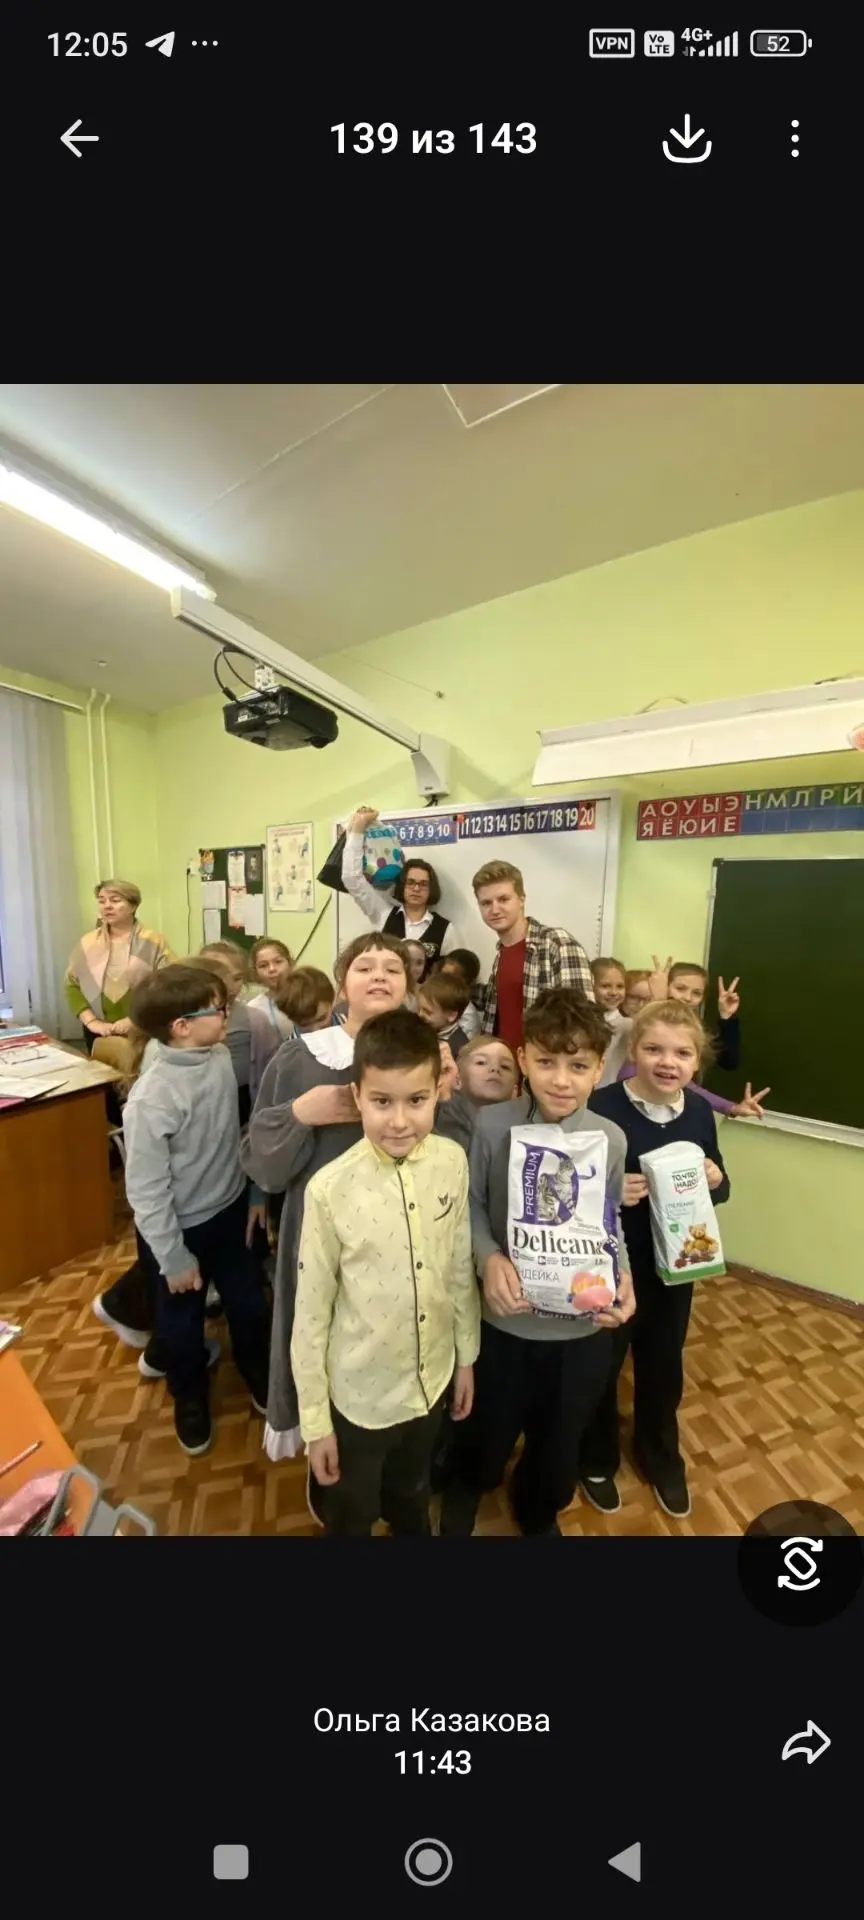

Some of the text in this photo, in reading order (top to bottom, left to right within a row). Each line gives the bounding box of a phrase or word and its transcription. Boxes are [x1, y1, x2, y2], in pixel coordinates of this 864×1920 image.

[399, 828, 406, 840] 6
[408, 826, 415, 839] 7
[417, 825, 425, 839] 8
[426, 824, 434, 837] 9
[436, 823, 450, 837] 10
[471, 816, 482, 834] 12
[483, 815, 494, 833] 13
[495, 814, 507, 832] 14
[509, 813, 521, 831] 15
[523, 812, 535, 830] 16
[536, 810, 549, 828] 17
[550, 809, 563, 827] 18
[565, 808, 579, 826] 19
[580, 808, 595, 826] 20
[524, 1151, 541, 1216] PREMIUM
